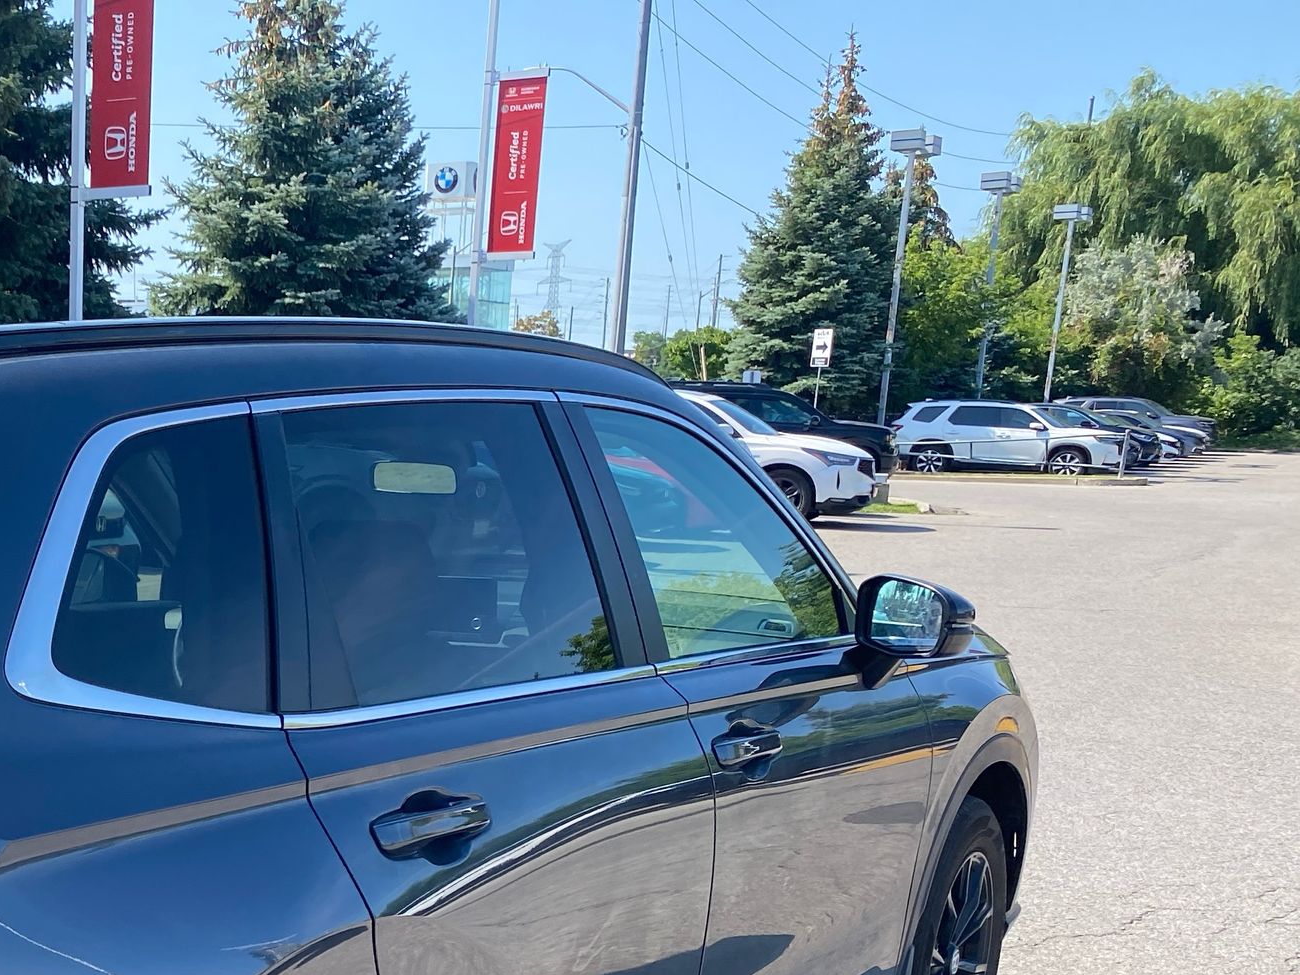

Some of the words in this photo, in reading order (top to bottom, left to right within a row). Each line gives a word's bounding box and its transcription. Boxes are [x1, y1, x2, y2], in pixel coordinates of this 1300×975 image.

[111, 13, 126, 82] Certified
[126, 11, 135, 80] PRE-OWNED
[510, 102, 544, 112] DILAWRI
[127, 111, 137, 173] HONDA
[507, 131, 520, 181] Certified
[519, 130, 529, 179] PRE-OWNED
[517, 200, 528, 244] HONDA
